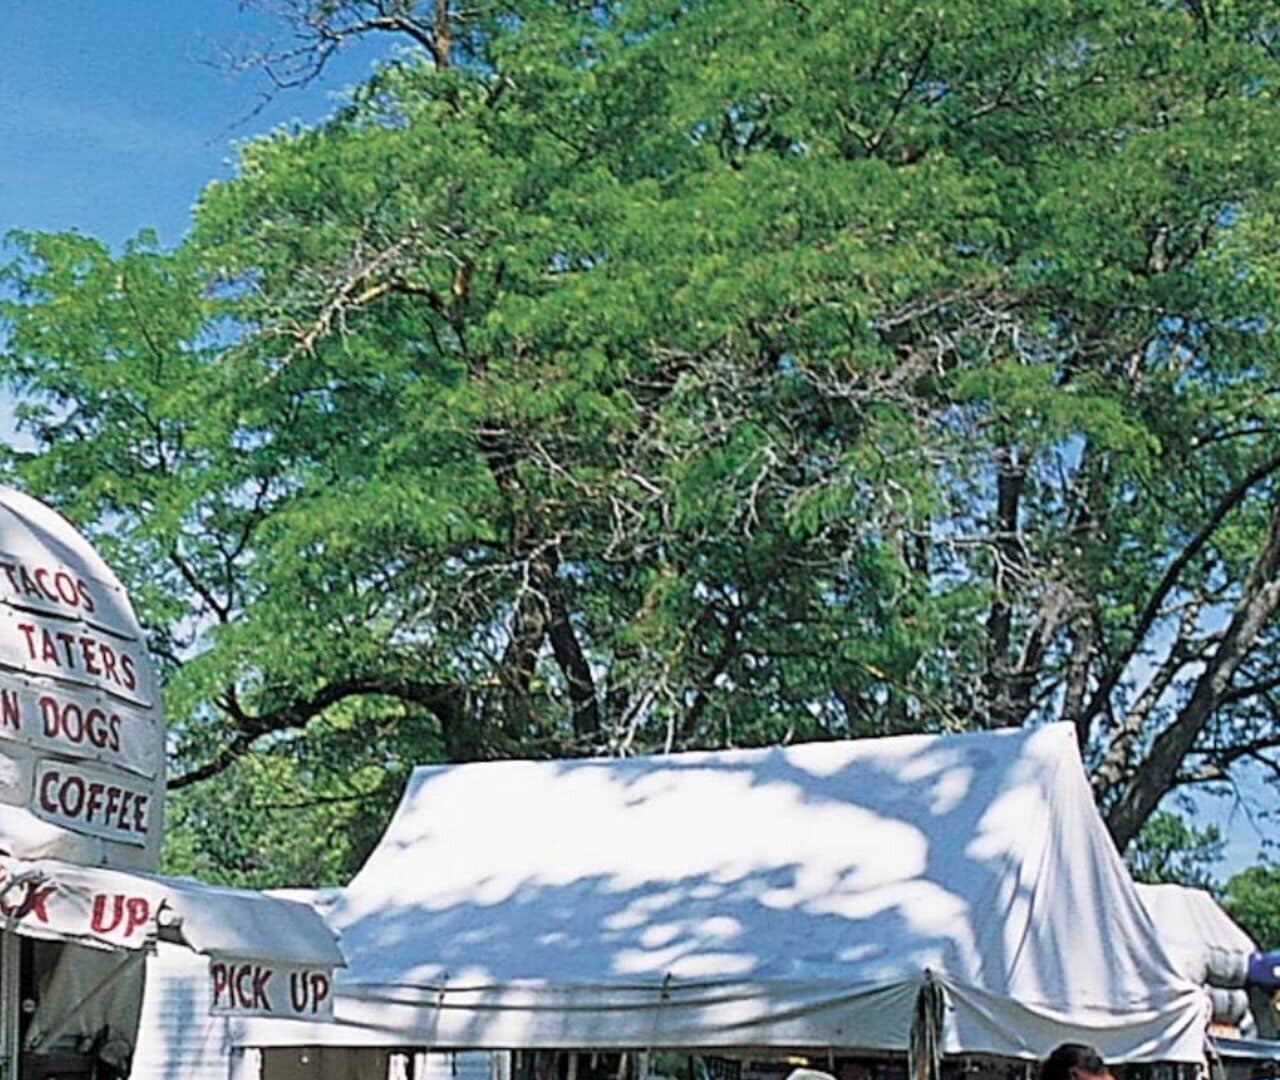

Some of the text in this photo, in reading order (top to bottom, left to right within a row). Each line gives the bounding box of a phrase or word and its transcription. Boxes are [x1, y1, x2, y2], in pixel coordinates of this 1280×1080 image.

[18, 624, 137, 692] TATERS
[42, 697, 121, 753] DOGS
[41, 770, 148, 834] COFFEE
[91, 893, 150, 938] UP
[214, 963, 329, 1014] PICK UP
